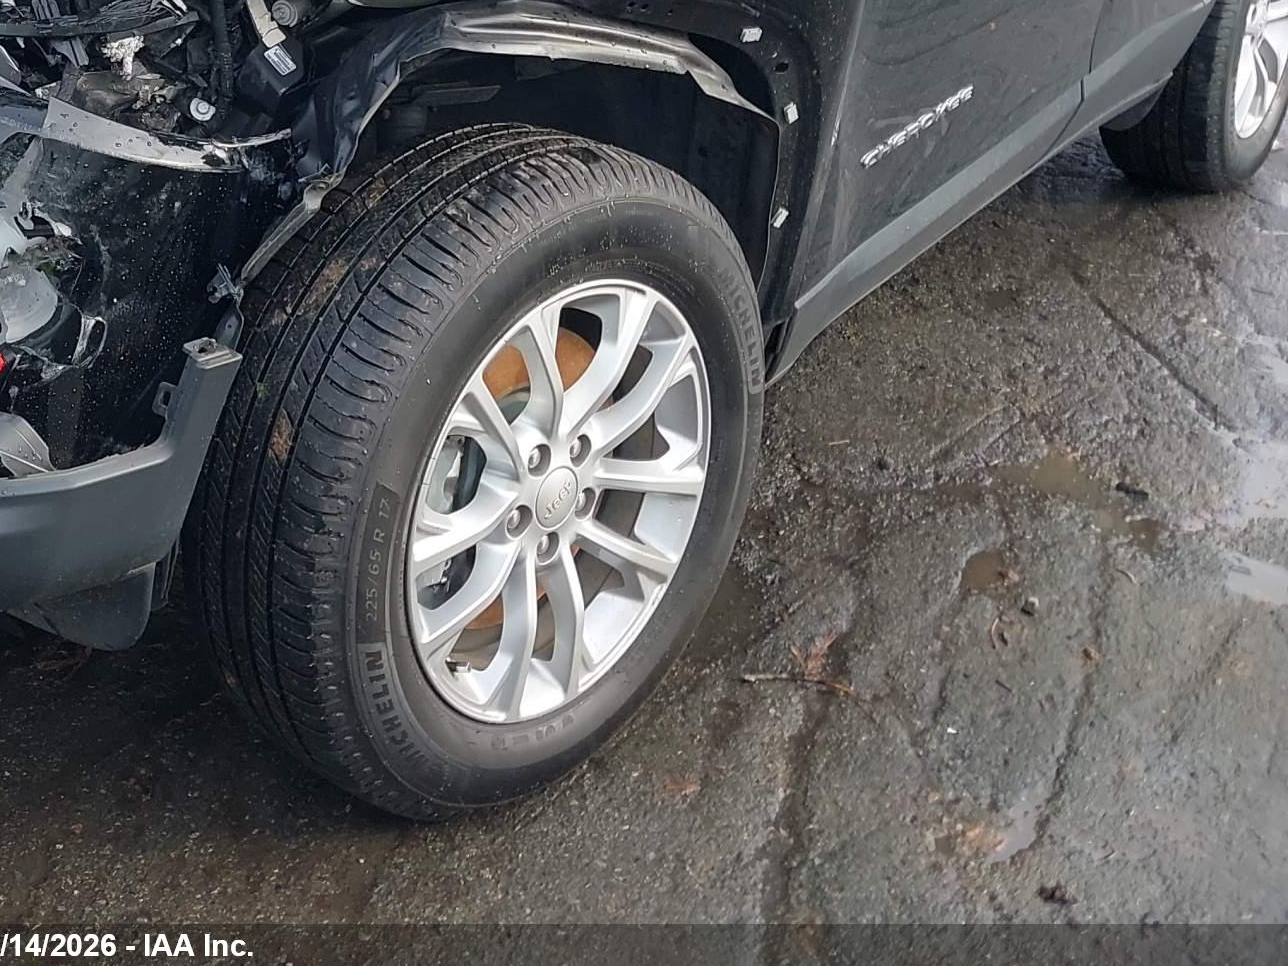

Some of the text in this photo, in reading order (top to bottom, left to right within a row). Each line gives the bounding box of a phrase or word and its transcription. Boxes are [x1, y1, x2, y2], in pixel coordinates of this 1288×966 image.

[860, 84, 974, 170] CHEROKEE
[543, 480, 572, 520] Jeep
[366, 497, 391, 622] 225/65 R 17
